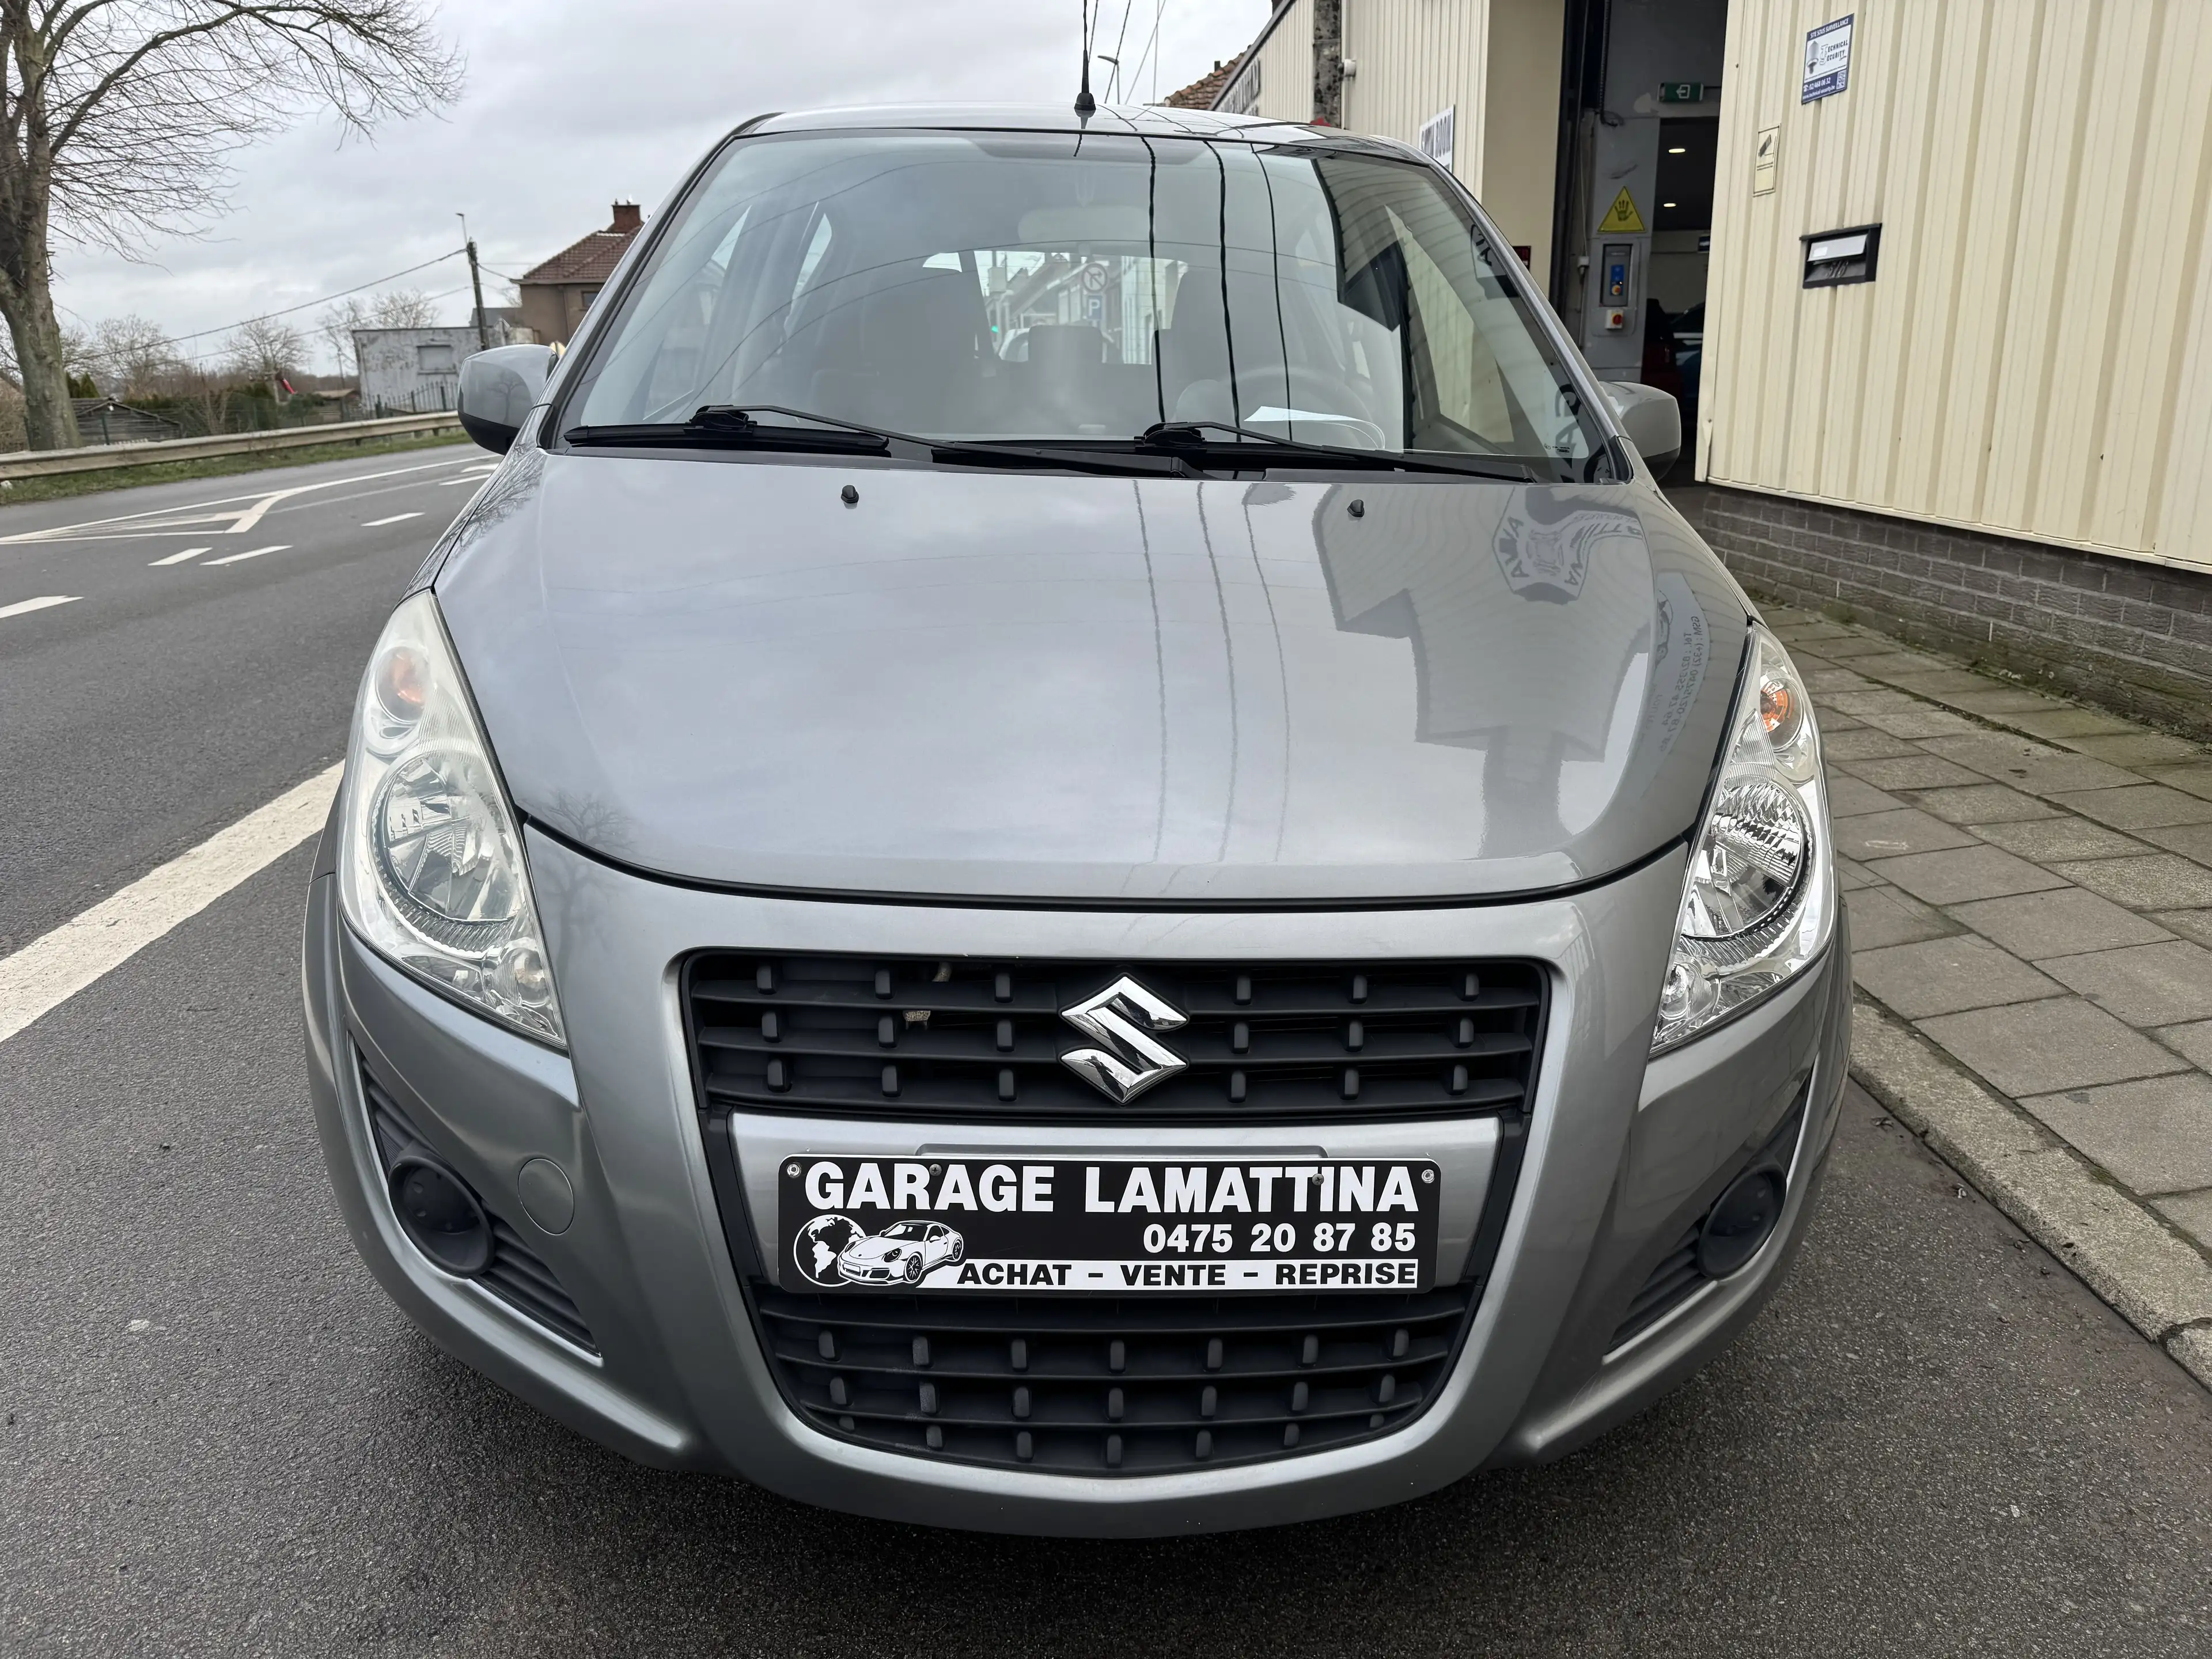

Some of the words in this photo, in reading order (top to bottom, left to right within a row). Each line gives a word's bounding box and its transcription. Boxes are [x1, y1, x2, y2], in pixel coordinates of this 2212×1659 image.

[1817, 28, 1825, 36] SOUS
[1825, 18, 1849, 33] SURVEILLANCE
[1089, 300, 1100, 317] P
[805, 1161, 1054, 1212] GARAGE
[1085, 1166, 1419, 1213] LAMATTINA
[1143, 1224, 1233, 1253] 0475
[1250, 1223, 1296, 1252] 20
[1313, 1222, 1355, 1252] 87
[1370, 1222, 1415, 1252] 85
[957, 1263, 1072, 1286] ACHAT
[1120, 1264, 1226, 1286] VENTE
[1275, 1263, 1416, 1285] REPRISE
